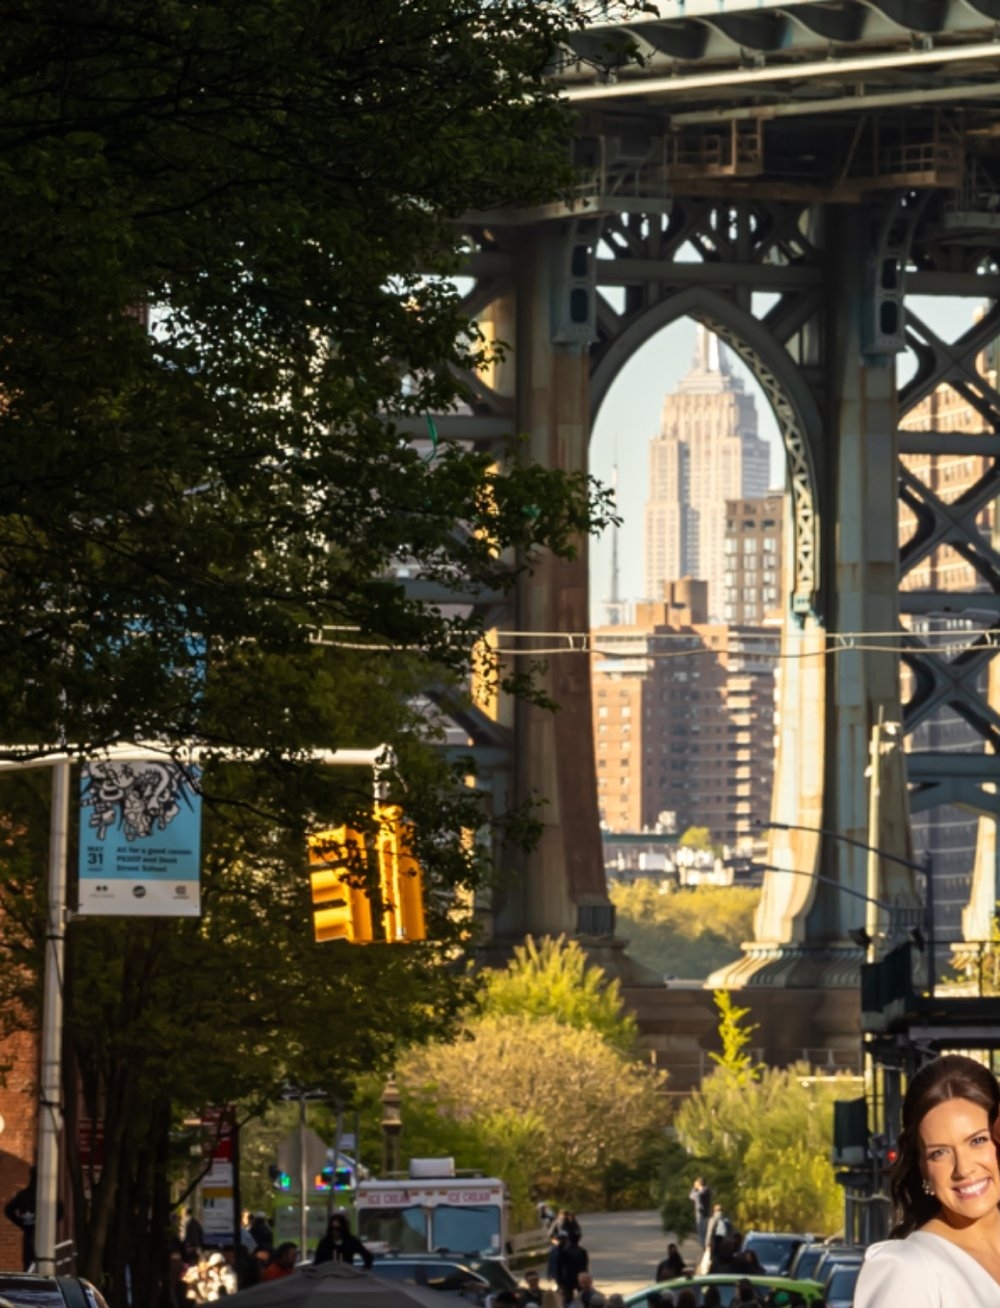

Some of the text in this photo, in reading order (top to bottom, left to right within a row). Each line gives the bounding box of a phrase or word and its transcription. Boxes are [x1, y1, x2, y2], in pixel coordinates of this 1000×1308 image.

[88, 853, 103, 864] 31
[368, 1194, 410, 1204] ICE CREAM
[448, 1192, 490, 1203] ICE CREAM
